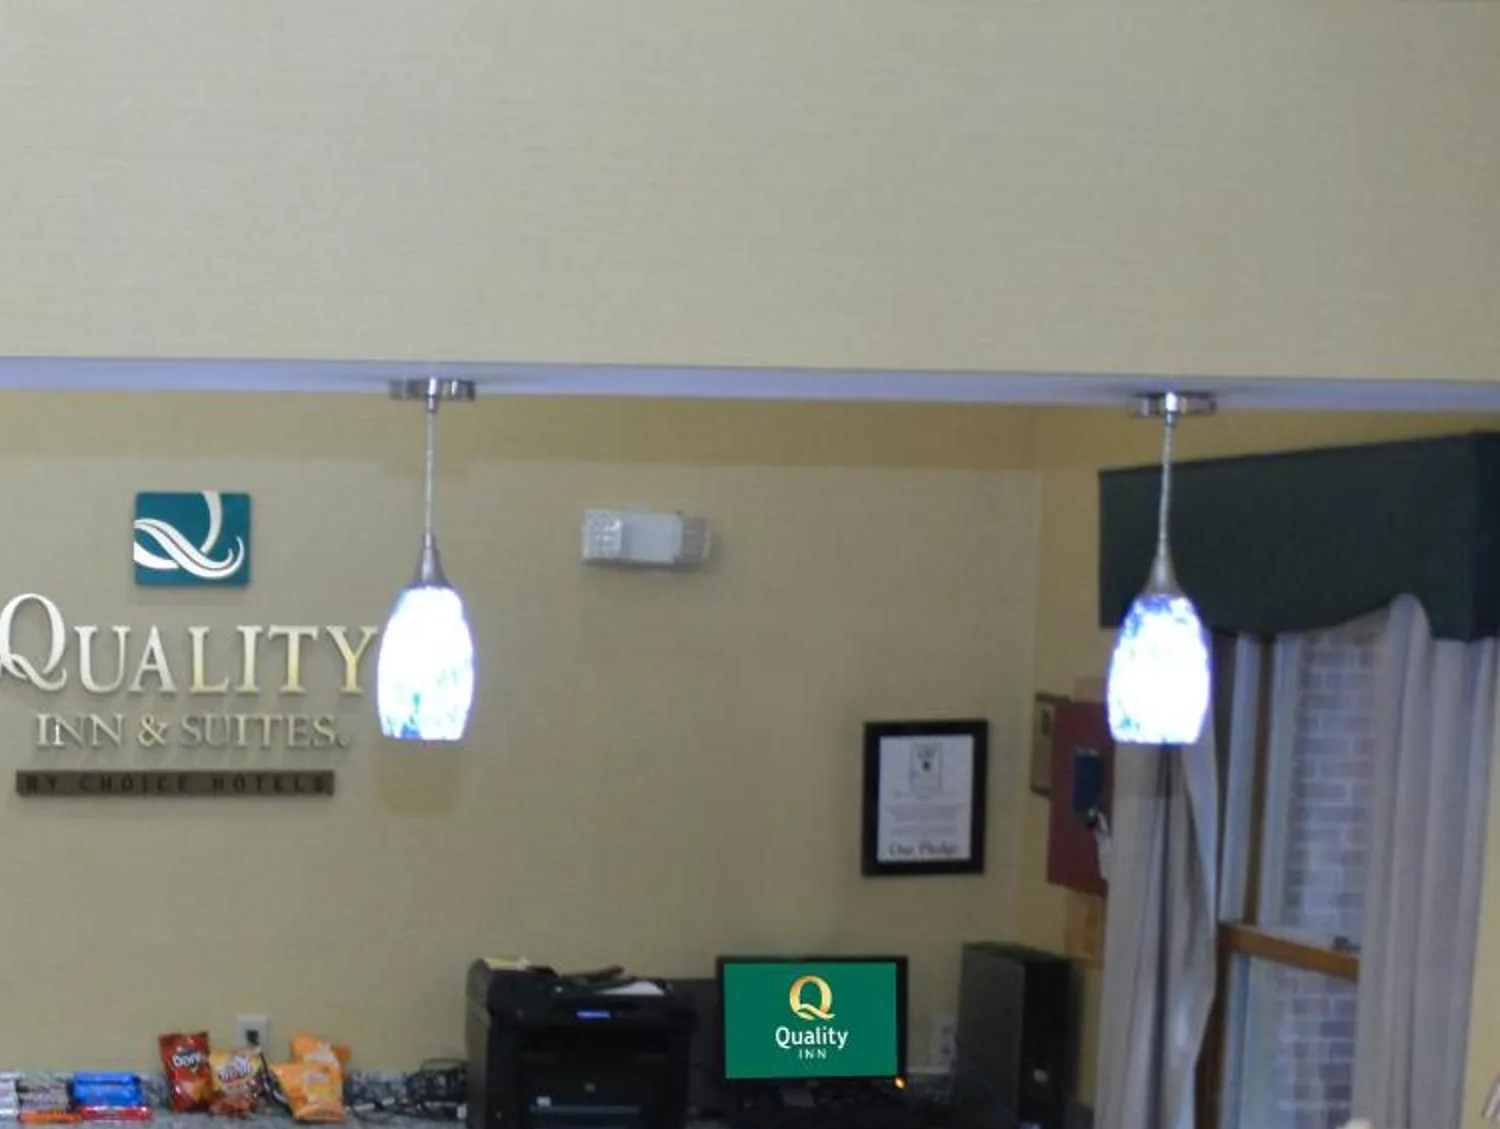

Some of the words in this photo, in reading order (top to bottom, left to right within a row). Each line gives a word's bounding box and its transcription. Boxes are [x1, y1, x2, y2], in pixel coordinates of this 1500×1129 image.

[35, 713, 124, 748] INN
[136, 713, 171, 747] &
[76, 773, 189, 792] CHOICE
[211, 773, 327, 792] HOTELS
[775, 1025, 849, 1049] Quality
[798, 1048, 827, 1059] INN
